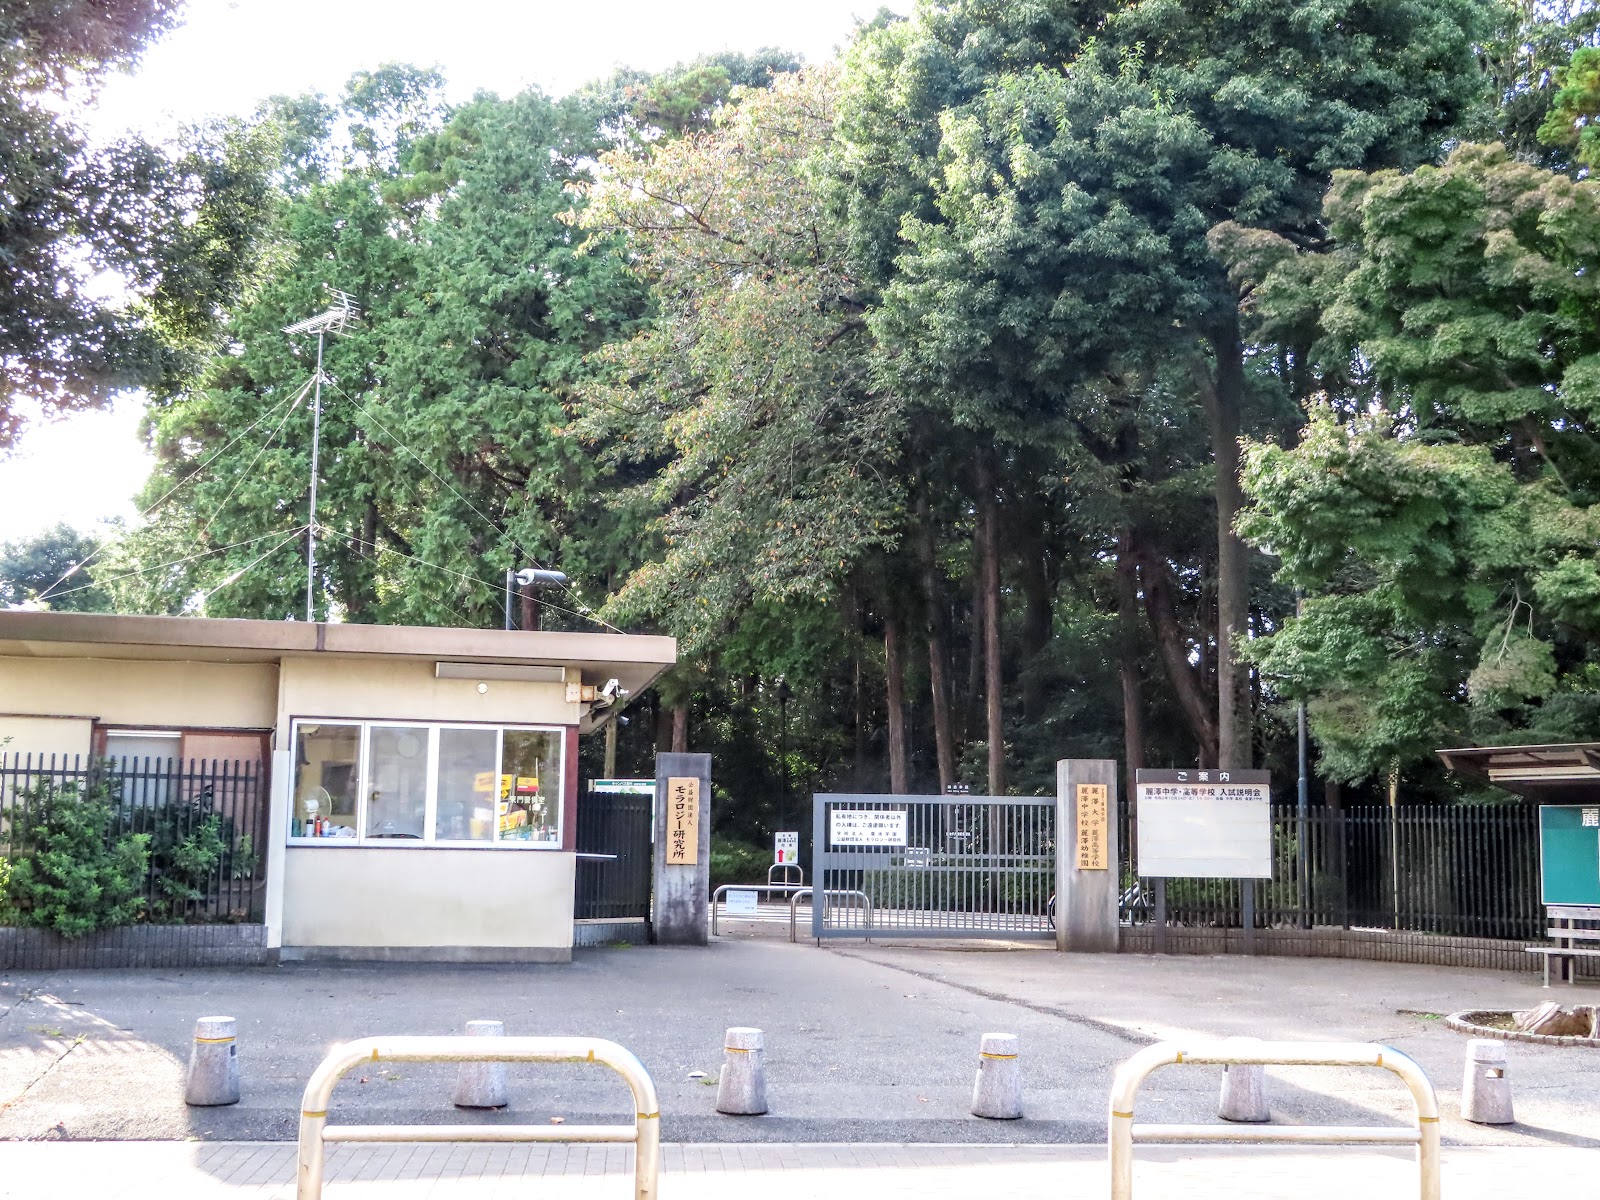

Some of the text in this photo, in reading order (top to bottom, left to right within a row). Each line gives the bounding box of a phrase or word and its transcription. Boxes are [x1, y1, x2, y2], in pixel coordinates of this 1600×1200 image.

[1177, 771, 1230, 782] ご案内
[1219, 788, 1261, 797] 入試説明会
[672, 785, 687, 860] モラロジー研究所
